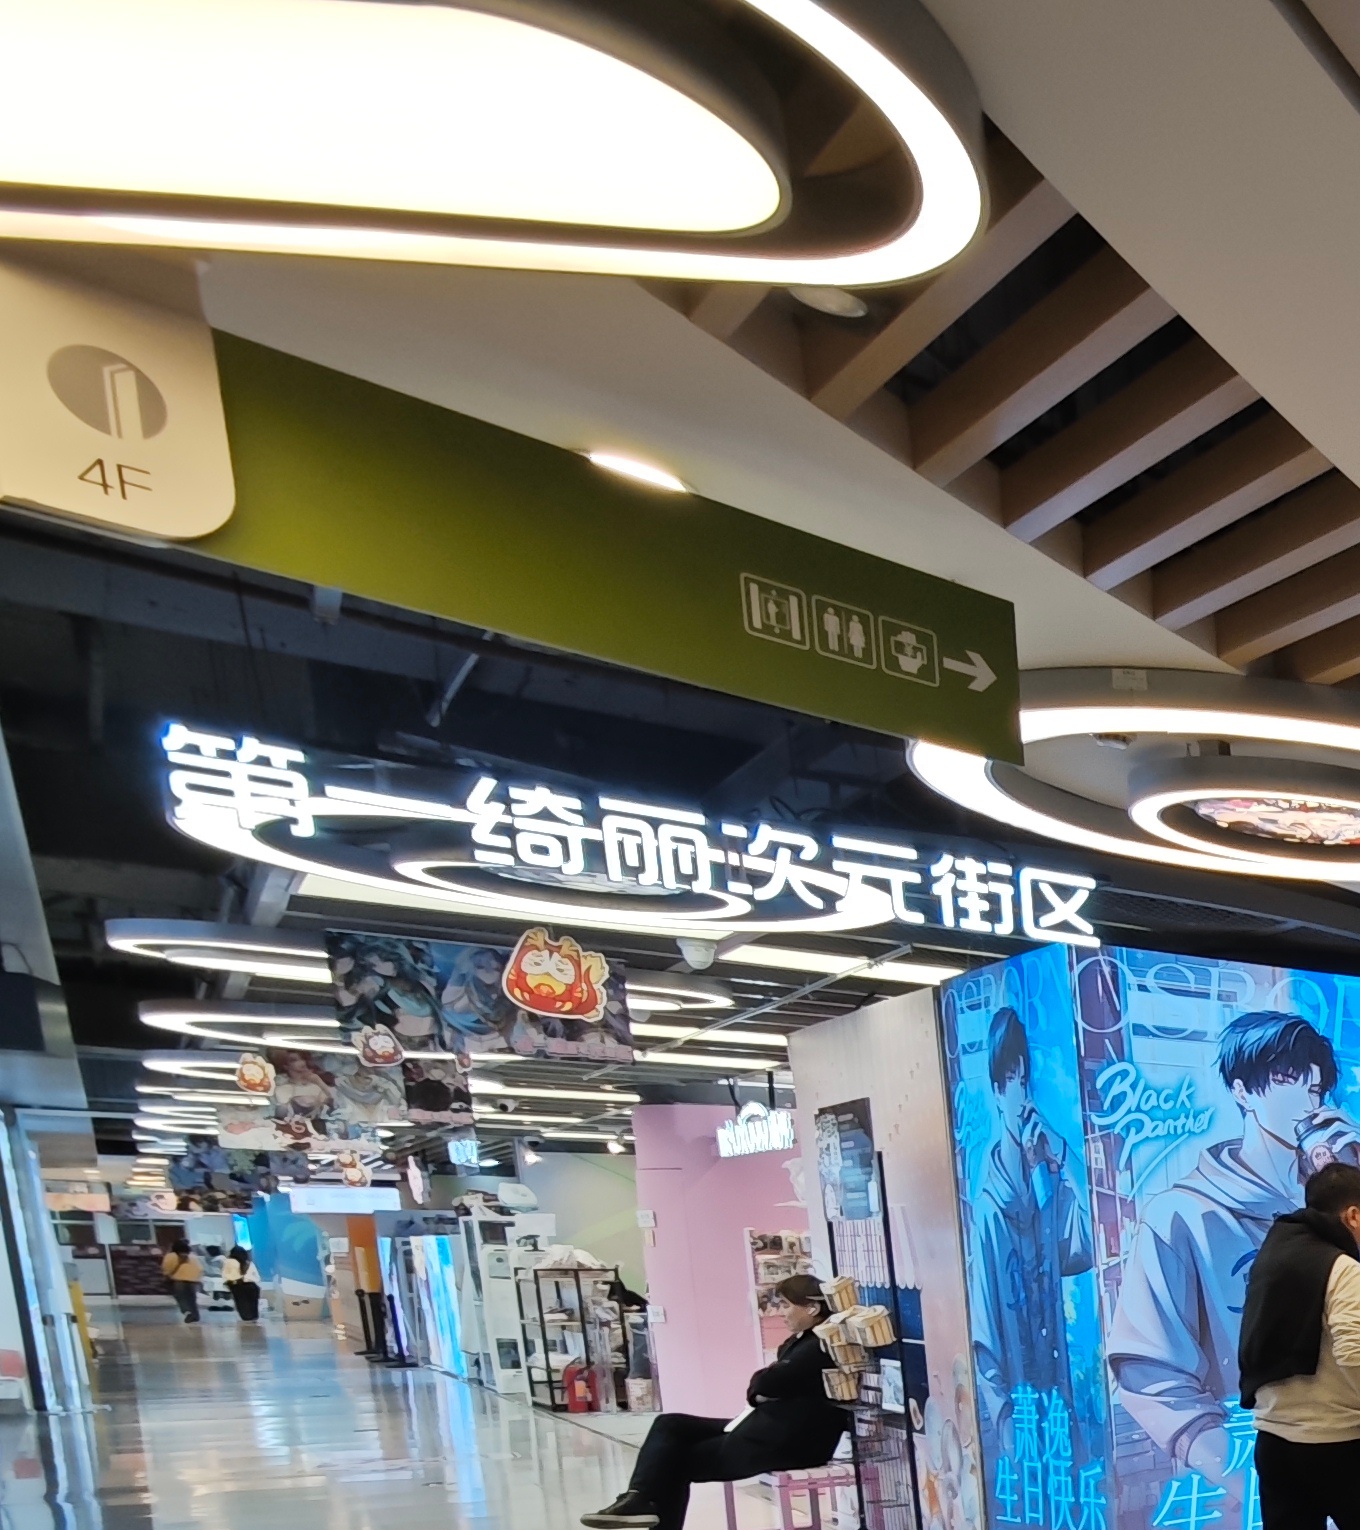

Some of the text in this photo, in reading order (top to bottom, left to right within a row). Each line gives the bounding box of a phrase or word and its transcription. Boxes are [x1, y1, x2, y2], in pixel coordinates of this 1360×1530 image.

[77, 457, 153, 502] 4F
[160, 719, 1101, 948] 第一绮丽次元街区
[1091, 1061, 1196, 1126] Black
[1114, 1107, 1216, 1172] Panther
[1011, 1385, 1072, 1463] 萧逸
